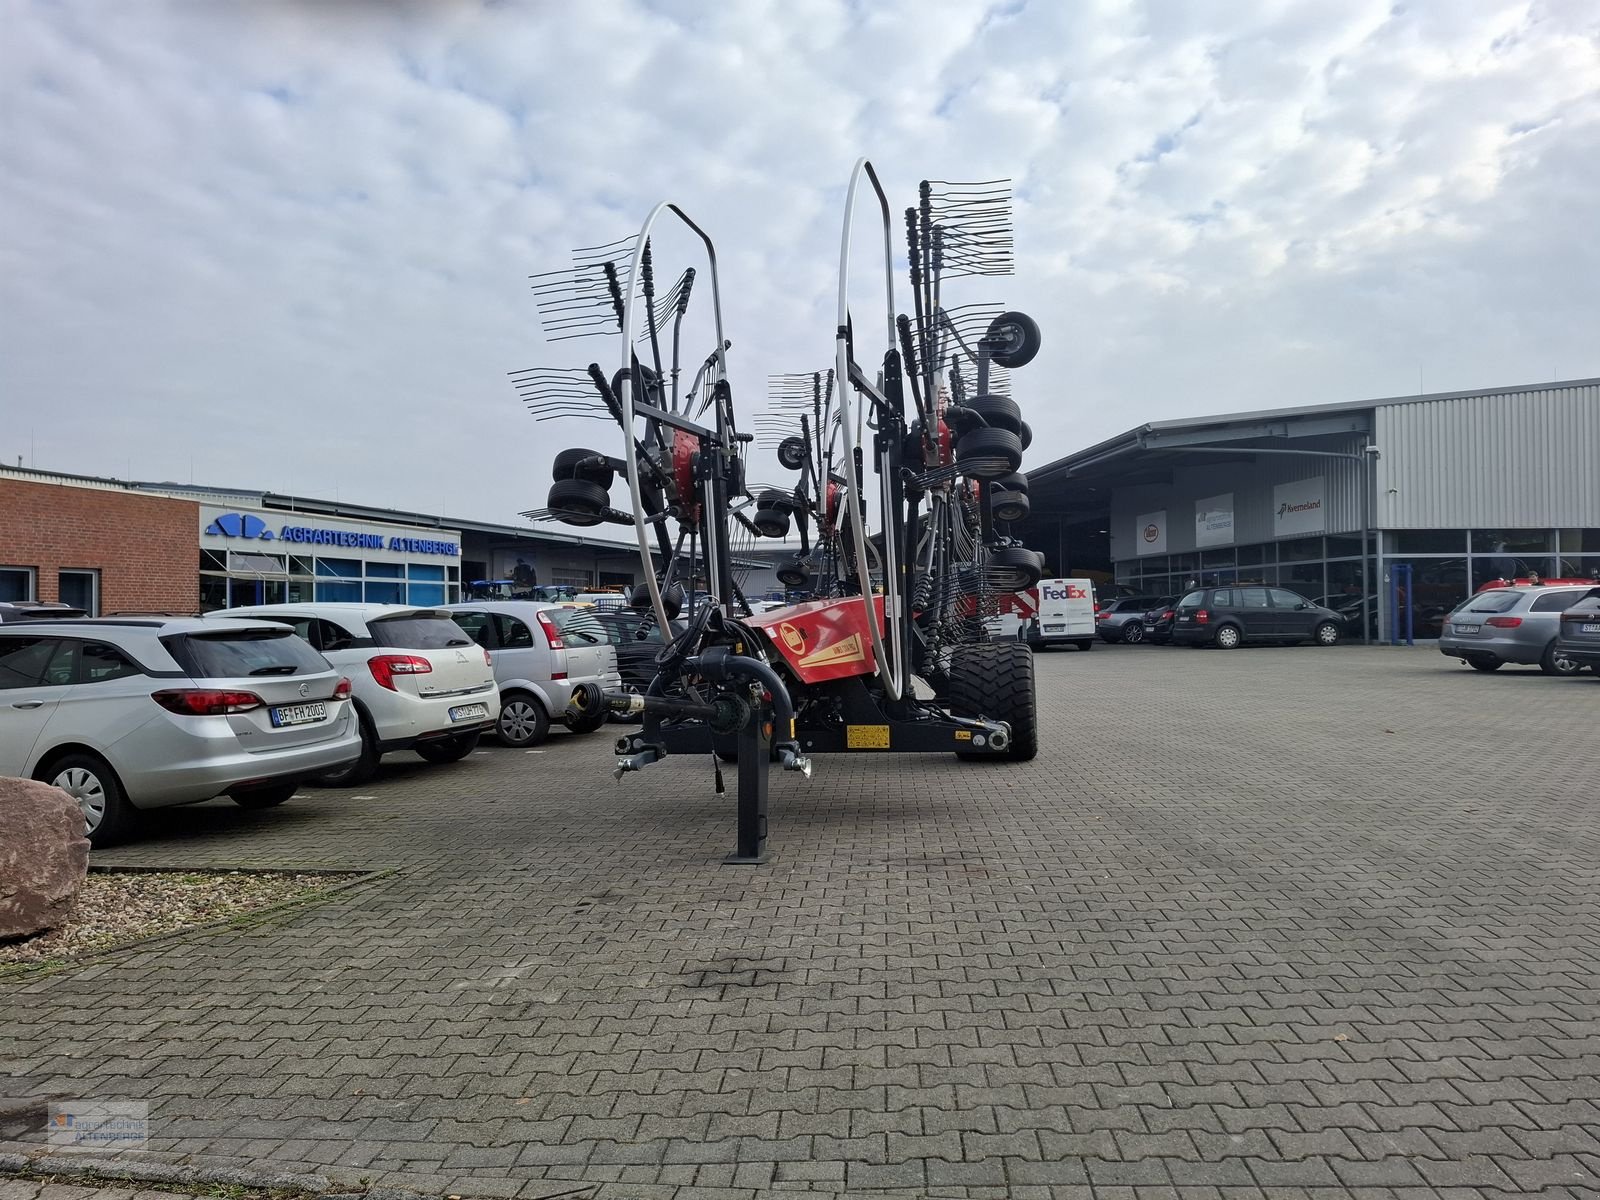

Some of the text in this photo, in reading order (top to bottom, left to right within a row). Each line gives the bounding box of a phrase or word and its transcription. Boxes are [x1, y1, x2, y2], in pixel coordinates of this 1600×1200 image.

[281, 526, 460, 556] AGRARTECHNIK ALTENBERGE
[1043, 585, 1087, 600] FedEx
[278, 709, 289, 721] BF
[294, 707, 306, 719] FH
[306, 704, 325, 717] 2003
